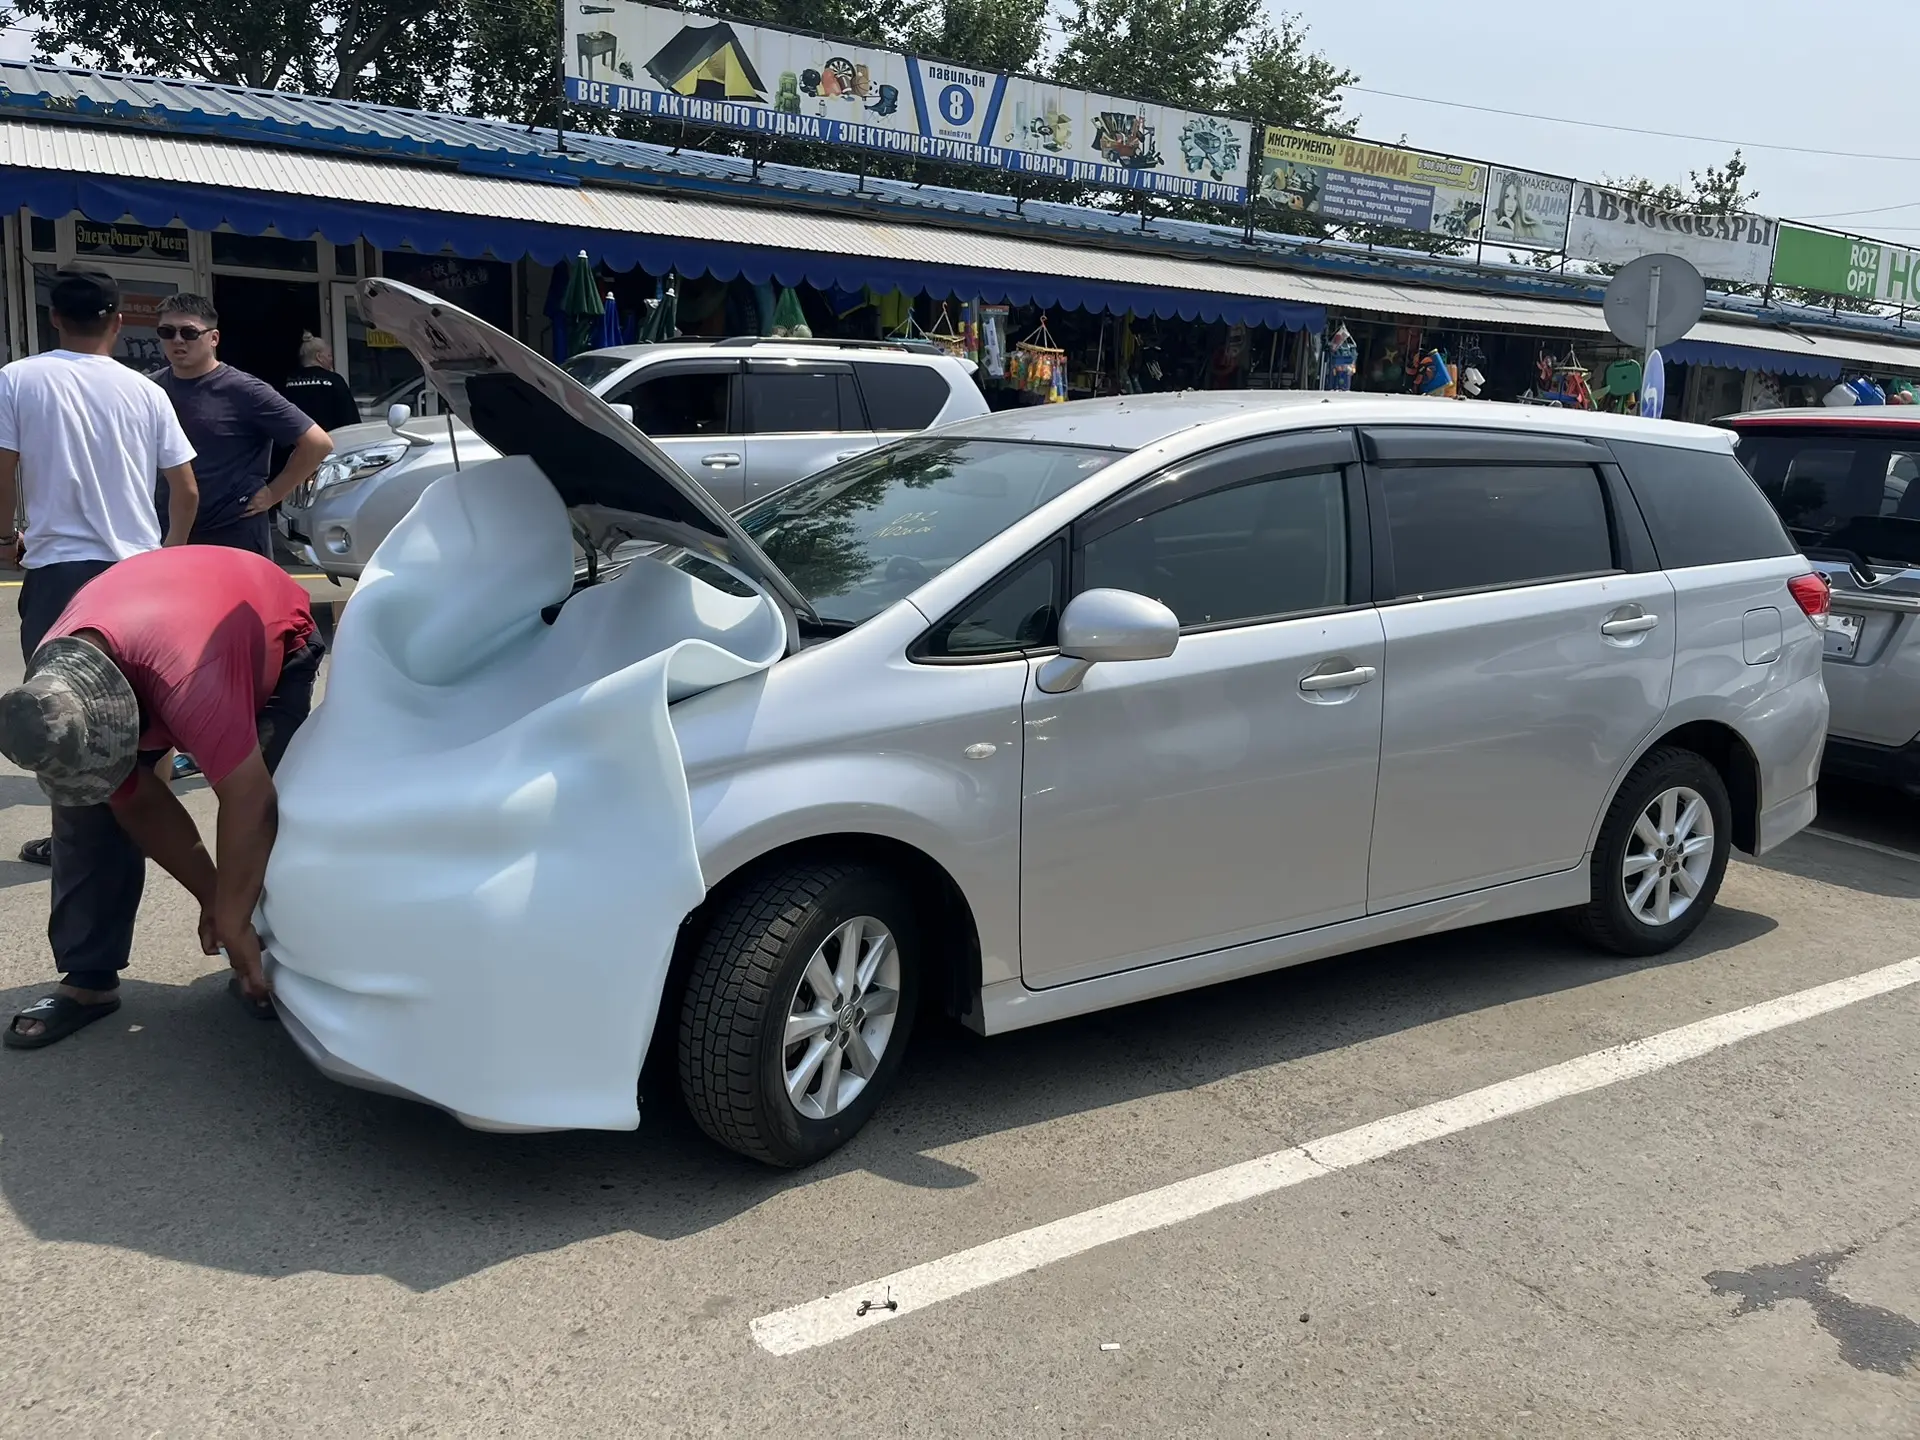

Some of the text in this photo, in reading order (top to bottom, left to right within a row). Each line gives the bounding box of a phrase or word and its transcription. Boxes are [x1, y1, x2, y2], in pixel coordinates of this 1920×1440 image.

[929, 66, 985, 88] павильон
[949, 90, 964, 120] 8
[577, 80, 610, 105] ВСЕ
[618, 87, 652, 111] ДЛЯ
[658, 94, 751, 127] АКТИВНОГО
[756, 109, 820, 138] ОТДЫХА
[839, 122, 1002, 166] ЭЛЕКТРОИНСТРУМЕНТЫ
[1019, 152, 1067, 176] ТОВАРЫ
[1071, 161, 1097, 181] ДЛЯ
[1100, 166, 1129, 185] АВТО
[1143, 172, 1151, 189] И
[1155, 174, 1197, 196] МНОГОЕ
[1201, 182, 1240, 202] ДРУГОЕ
[1266, 148, 1289, 158] ОПТОМ
[1267, 132, 1336, 157] ИНСТРУМЕНТЫ
[1343, 145, 1409, 177] ВАДИМА
[1467, 166, 1481, 191] 9
[1525, 192, 1567, 216] ВАДИМ
[1575, 187, 1772, 246] АВТОТОВАРЫ
[1850, 244, 1878, 270] ROZ
[1846, 269, 1876, 294] OPT
